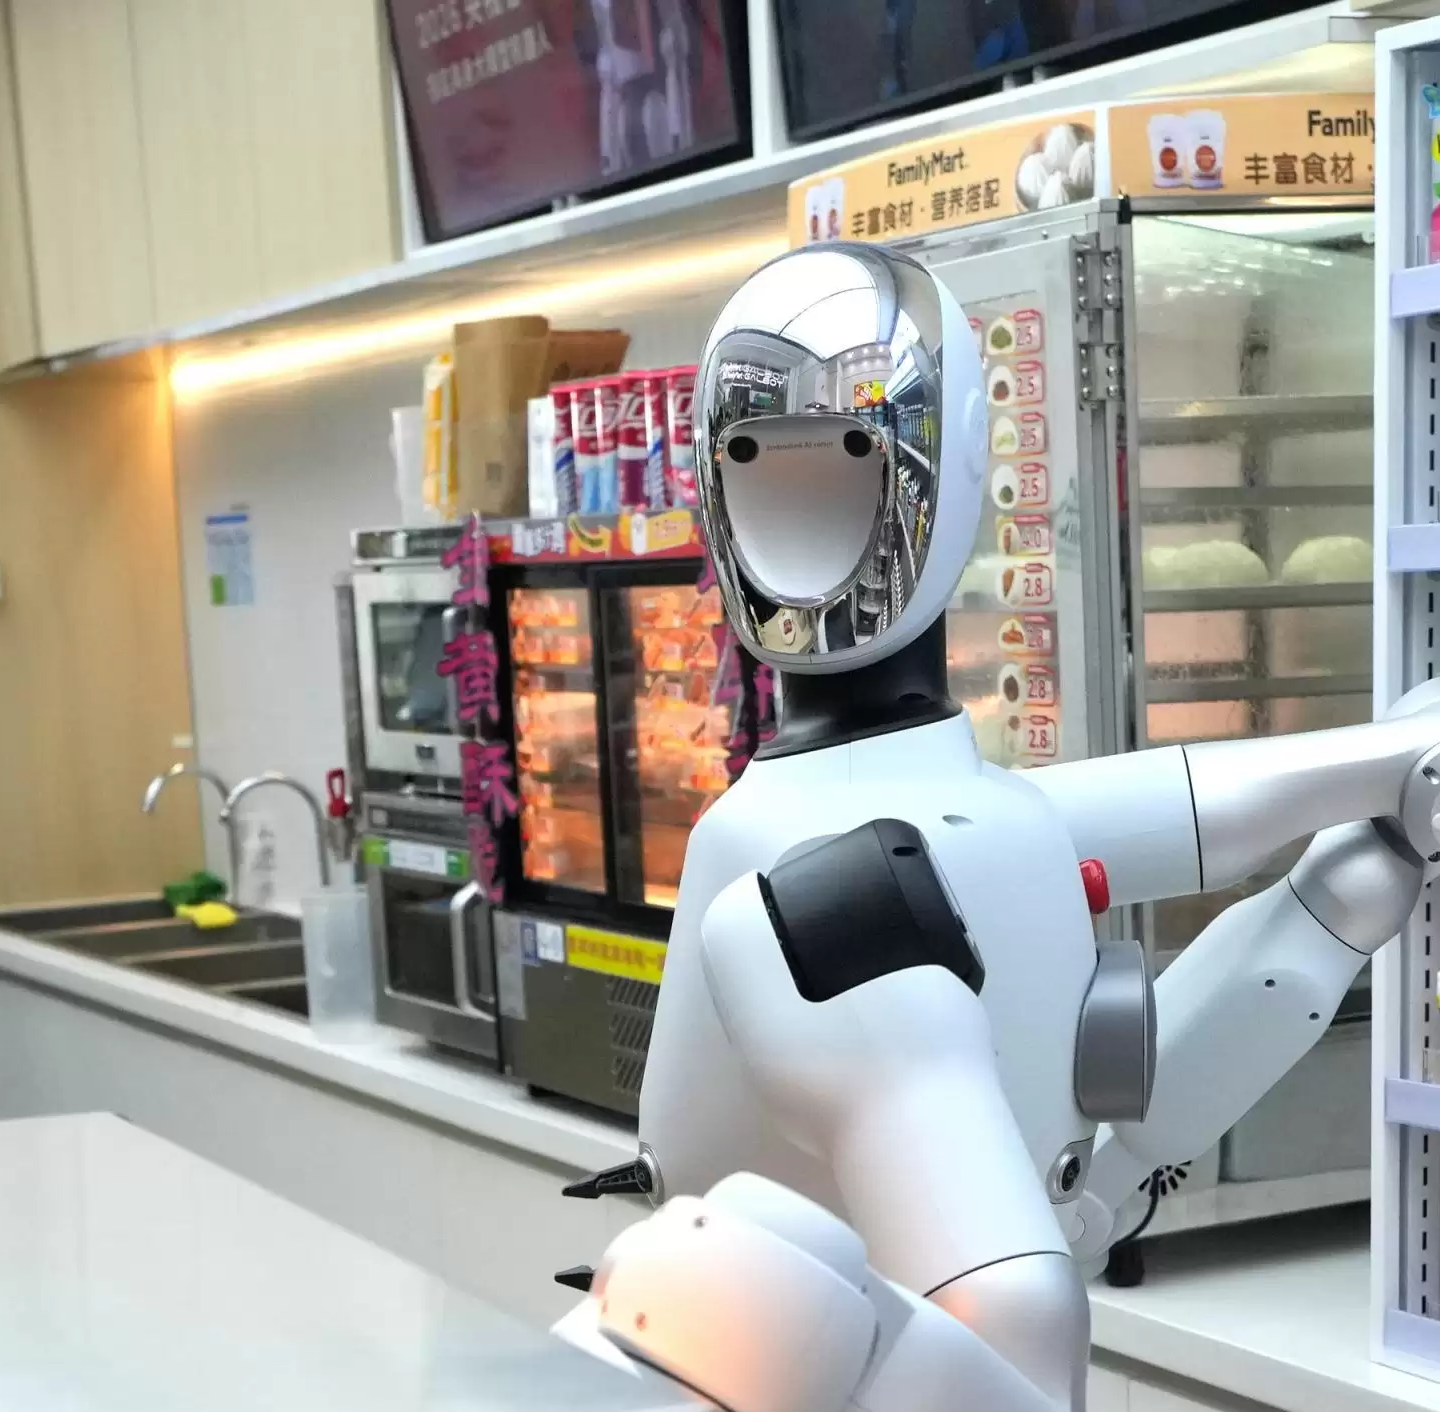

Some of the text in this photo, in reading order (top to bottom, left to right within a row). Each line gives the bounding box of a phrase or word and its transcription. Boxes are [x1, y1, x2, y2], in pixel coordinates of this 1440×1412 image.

[886, 148, 965, 188] FamilyMart
[1016, 377, 1035, 397] 2.5
[1020, 478, 1039, 499] 2.5
[1023, 577, 1043, 598] 2.8
[1027, 680, 1047, 699] 2.8
[1028, 729, 1048, 749] 2.8
